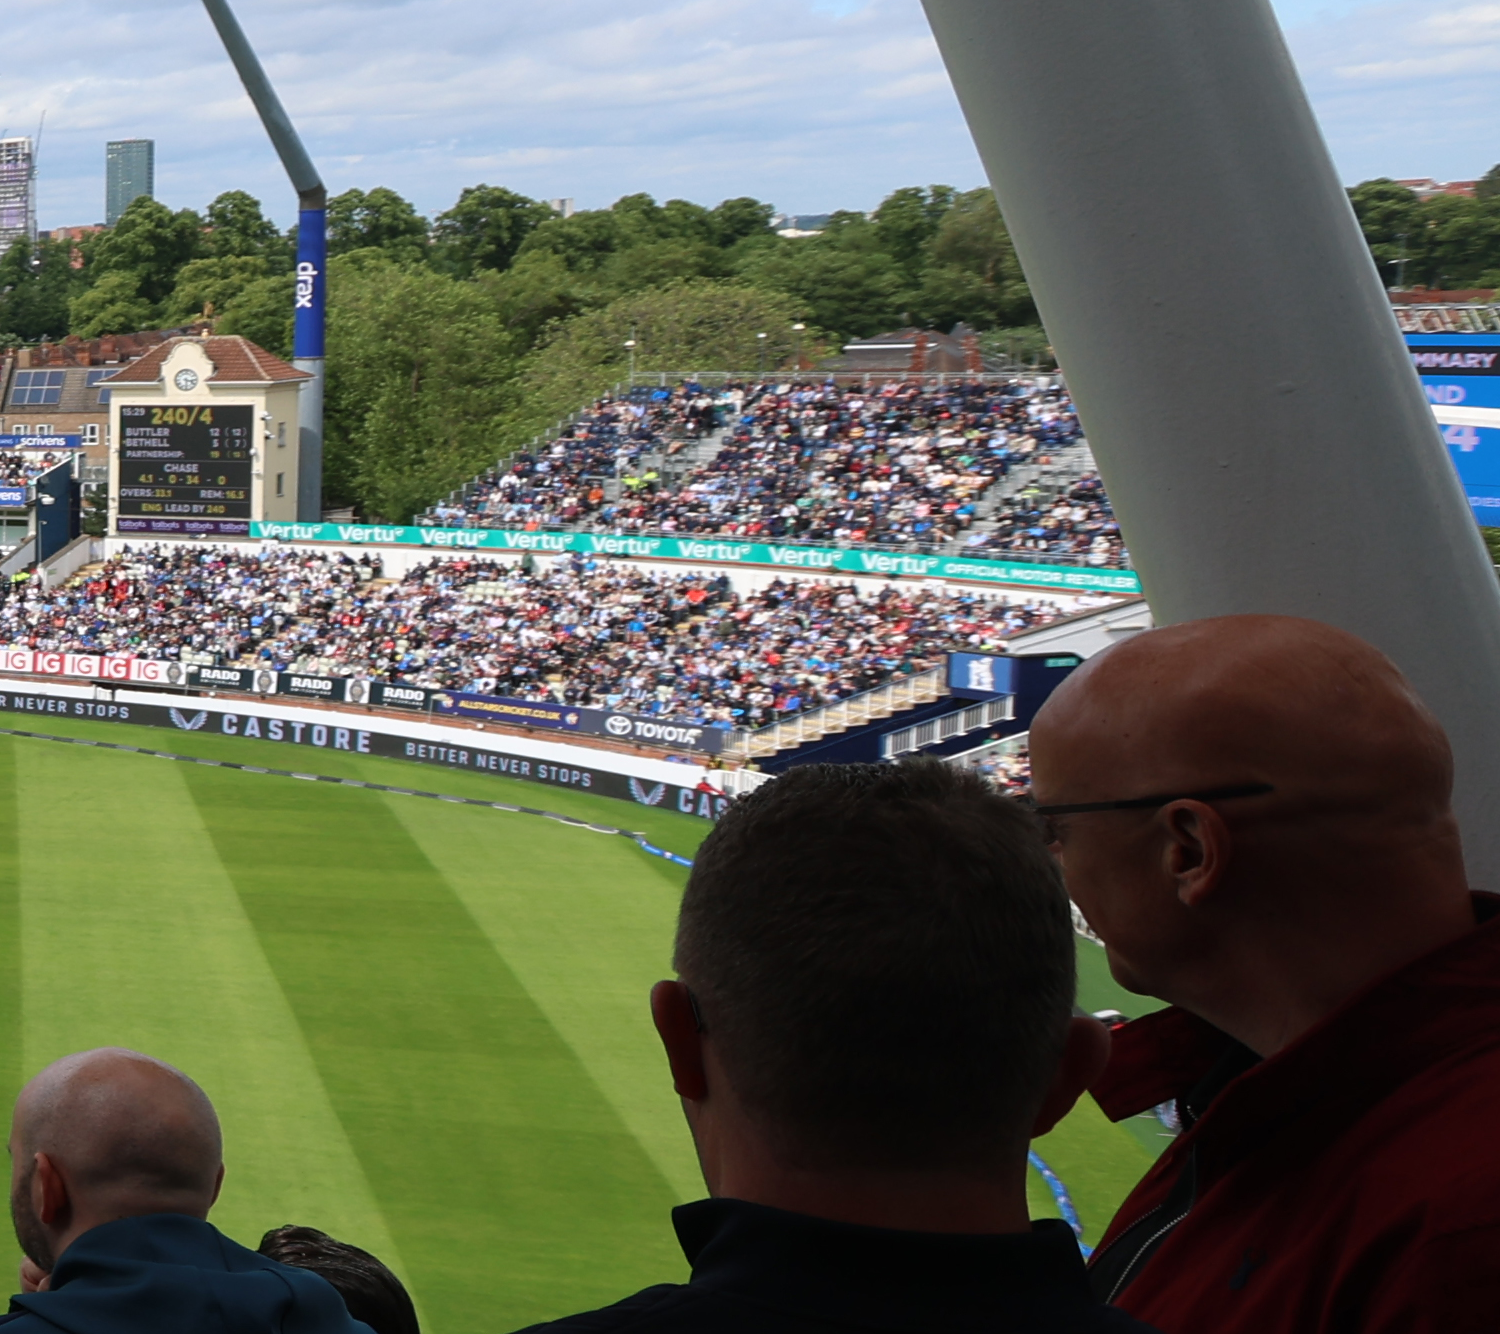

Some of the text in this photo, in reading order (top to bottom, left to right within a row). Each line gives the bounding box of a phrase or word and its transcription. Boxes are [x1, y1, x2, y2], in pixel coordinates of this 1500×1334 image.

[295, 261, 318, 308] drax
[1411, 352, 1498, 368] MMARY
[151, 407, 213, 426] 240/4
[21, 435, 66, 446] scrivens
[125, 428, 170, 436] BUTTLER
[210, 428, 220, 436] 12
[126, 438, 170, 447] BETHELL
[163, 464, 199, 473] CHASE
[165, 504, 190, 512] LEAD
[192, 504, 205, 513] BY
[207, 505, 225, 513] 240
[591, 536, 650, 555] Vertu
[678, 540, 741, 560] Vertu
[768, 546, 833, 567] Vertu
[861, 553, 1137, 588] Vertu OFFICIAL MOTOR RETAILER
[71, 656, 93, 674] IG
[103, 658, 129, 678] IG
[138, 661, 160, 680] IG
[201, 668, 241, 681] RADO
[290, 677, 332, 691] RADO
[383, 687, 425, 701] RADO
[14, 696, 67, 713] NEVER
[75, 702, 129, 719] STOPS
[222, 714, 371, 753] CASTORE
[406, 742, 592, 788] BETTER NEVER STOPS
